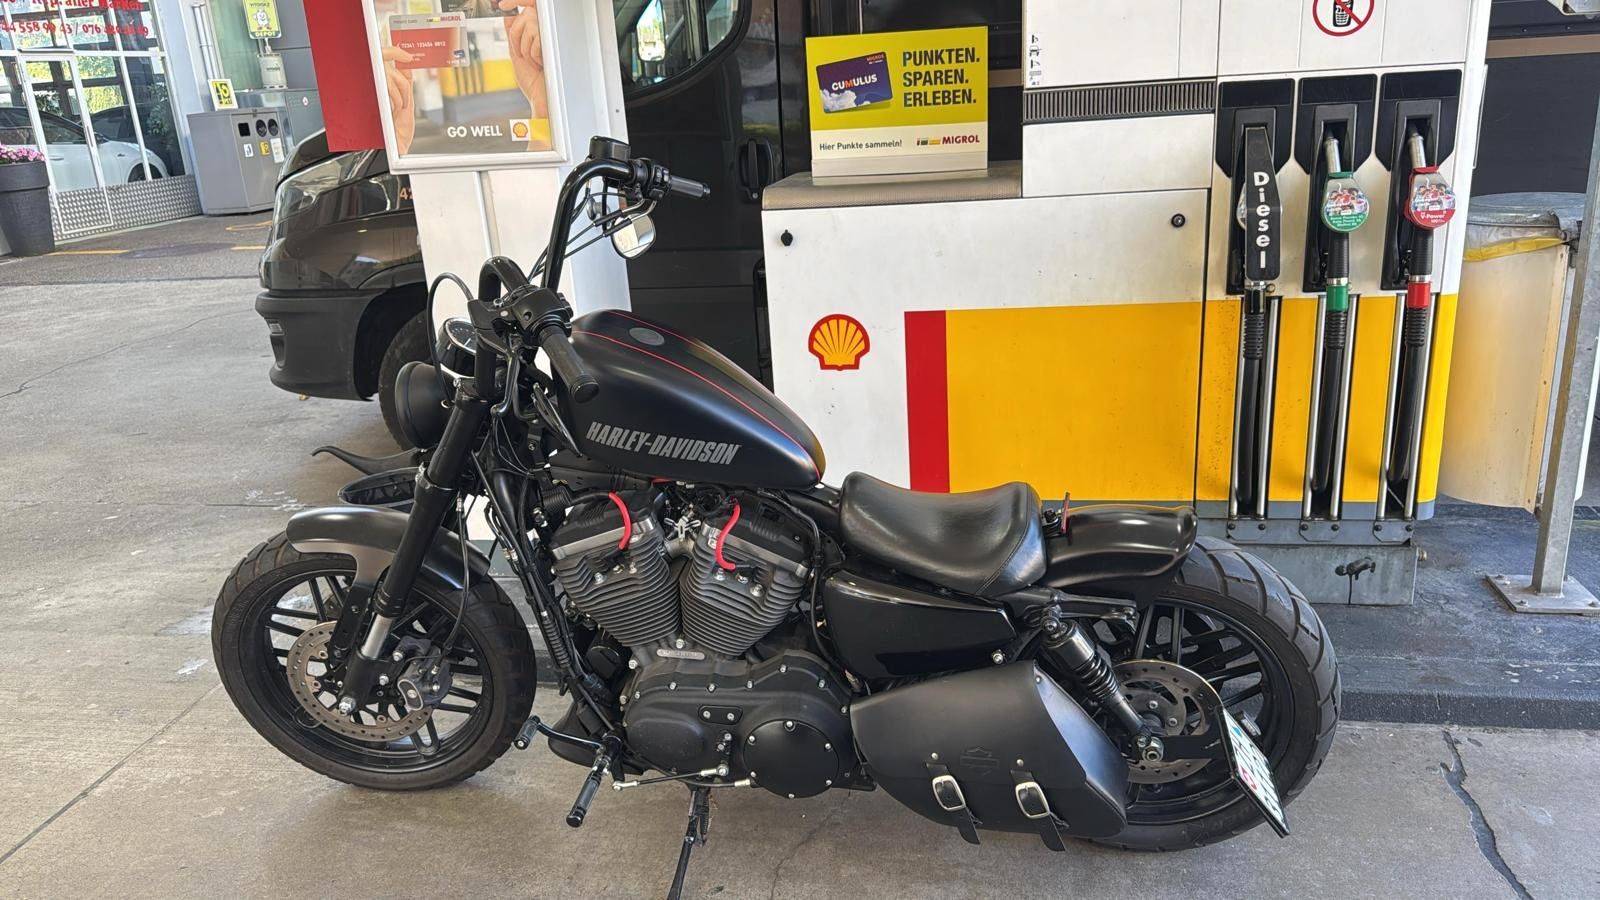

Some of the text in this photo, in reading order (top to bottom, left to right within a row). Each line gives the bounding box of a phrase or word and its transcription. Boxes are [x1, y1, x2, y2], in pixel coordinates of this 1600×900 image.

[19, 20, 42, 34] 558
[82, 23, 101, 35] 076
[902, 47, 980, 67] PUNKTEN.
[831, 73, 878, 91] CUMULUS
[902, 69, 969, 87] SPAREN.
[903, 89, 977, 107] ERLEBEN.
[446, 125, 503, 138] GO WELL
[942, 135, 980, 145] MIGROL
[819, 139, 902, 151] Hier Punkte sammeln!
[1253, 171, 1271, 269] Diesel
[585, 421, 743, 465] HARLEY-DAVIDSON
